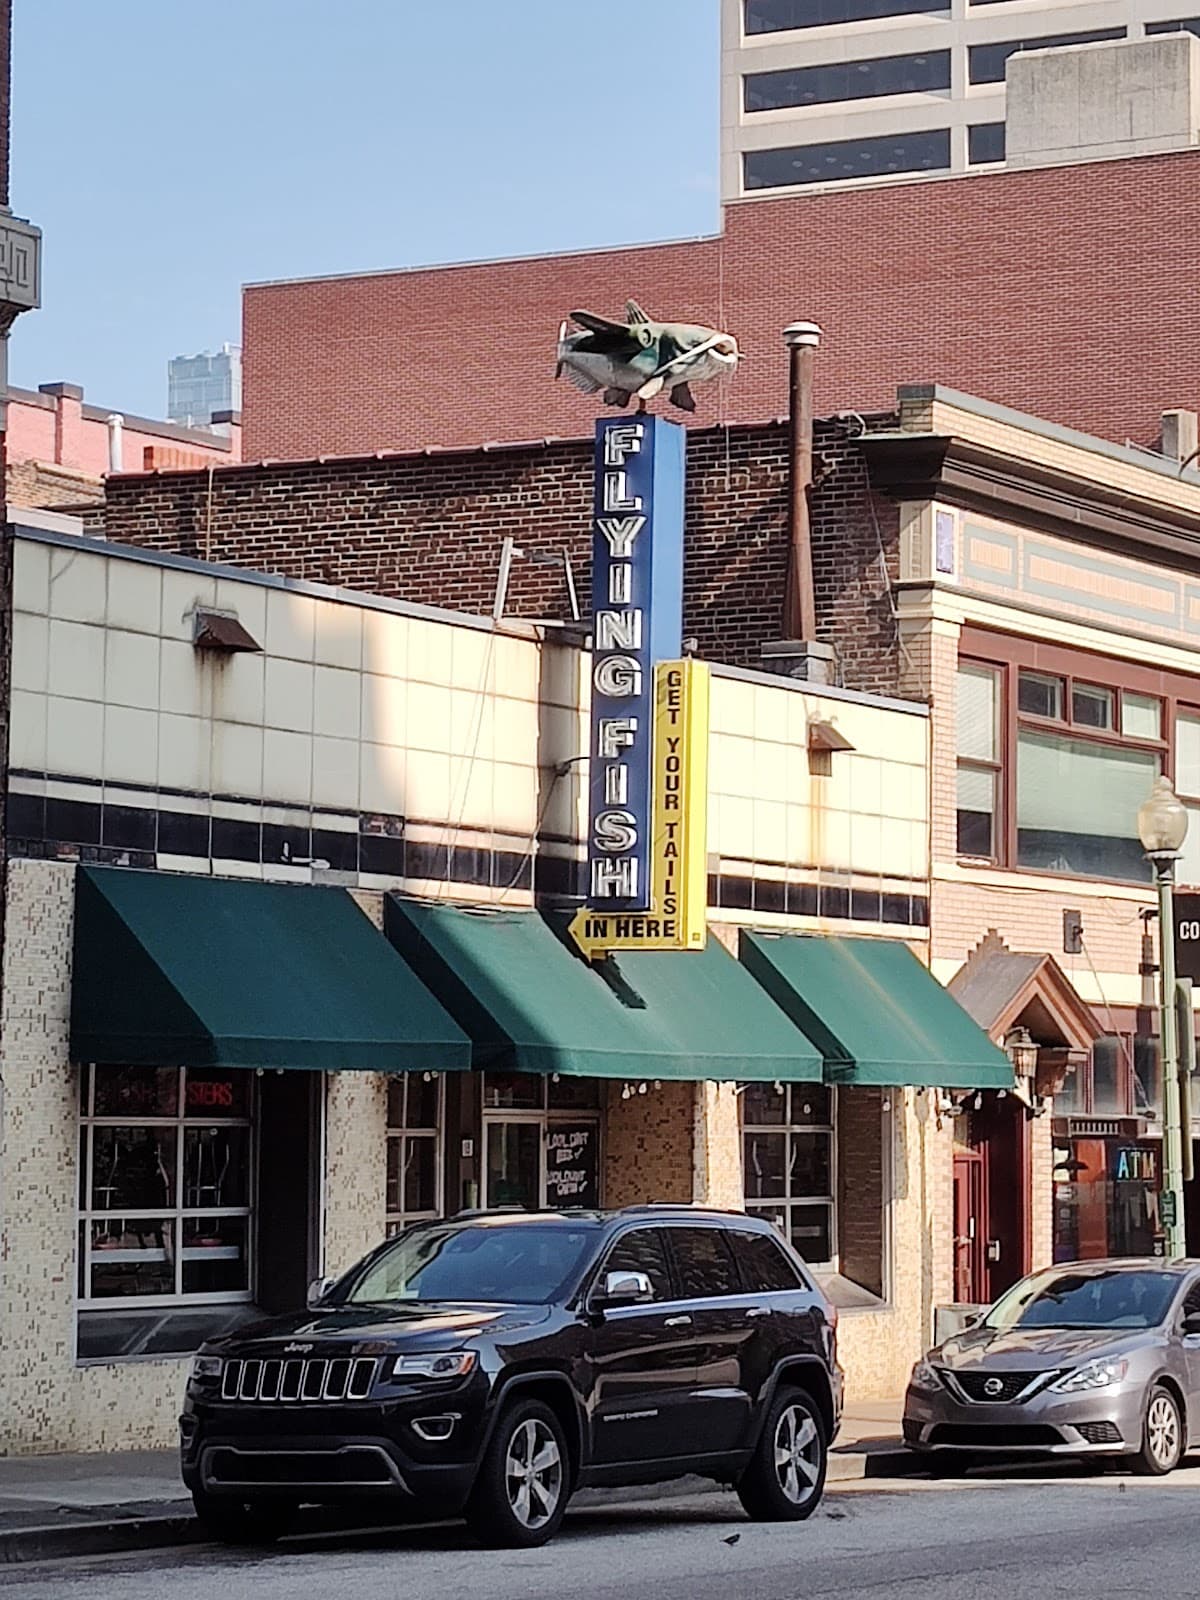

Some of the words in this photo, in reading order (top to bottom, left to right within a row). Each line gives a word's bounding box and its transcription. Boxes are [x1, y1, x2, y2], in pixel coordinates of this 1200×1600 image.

[593, 424, 647, 697] FLYING
[667, 671, 681, 725] GET
[591, 717, 638, 898] FISH
[665, 737, 681, 810] YOUR
[663, 822, 679, 915] TAILS
[585, 919, 607, 938] IN
[616, 919, 675, 938] HERE
[1117, 1151, 1155, 1179] ATM
